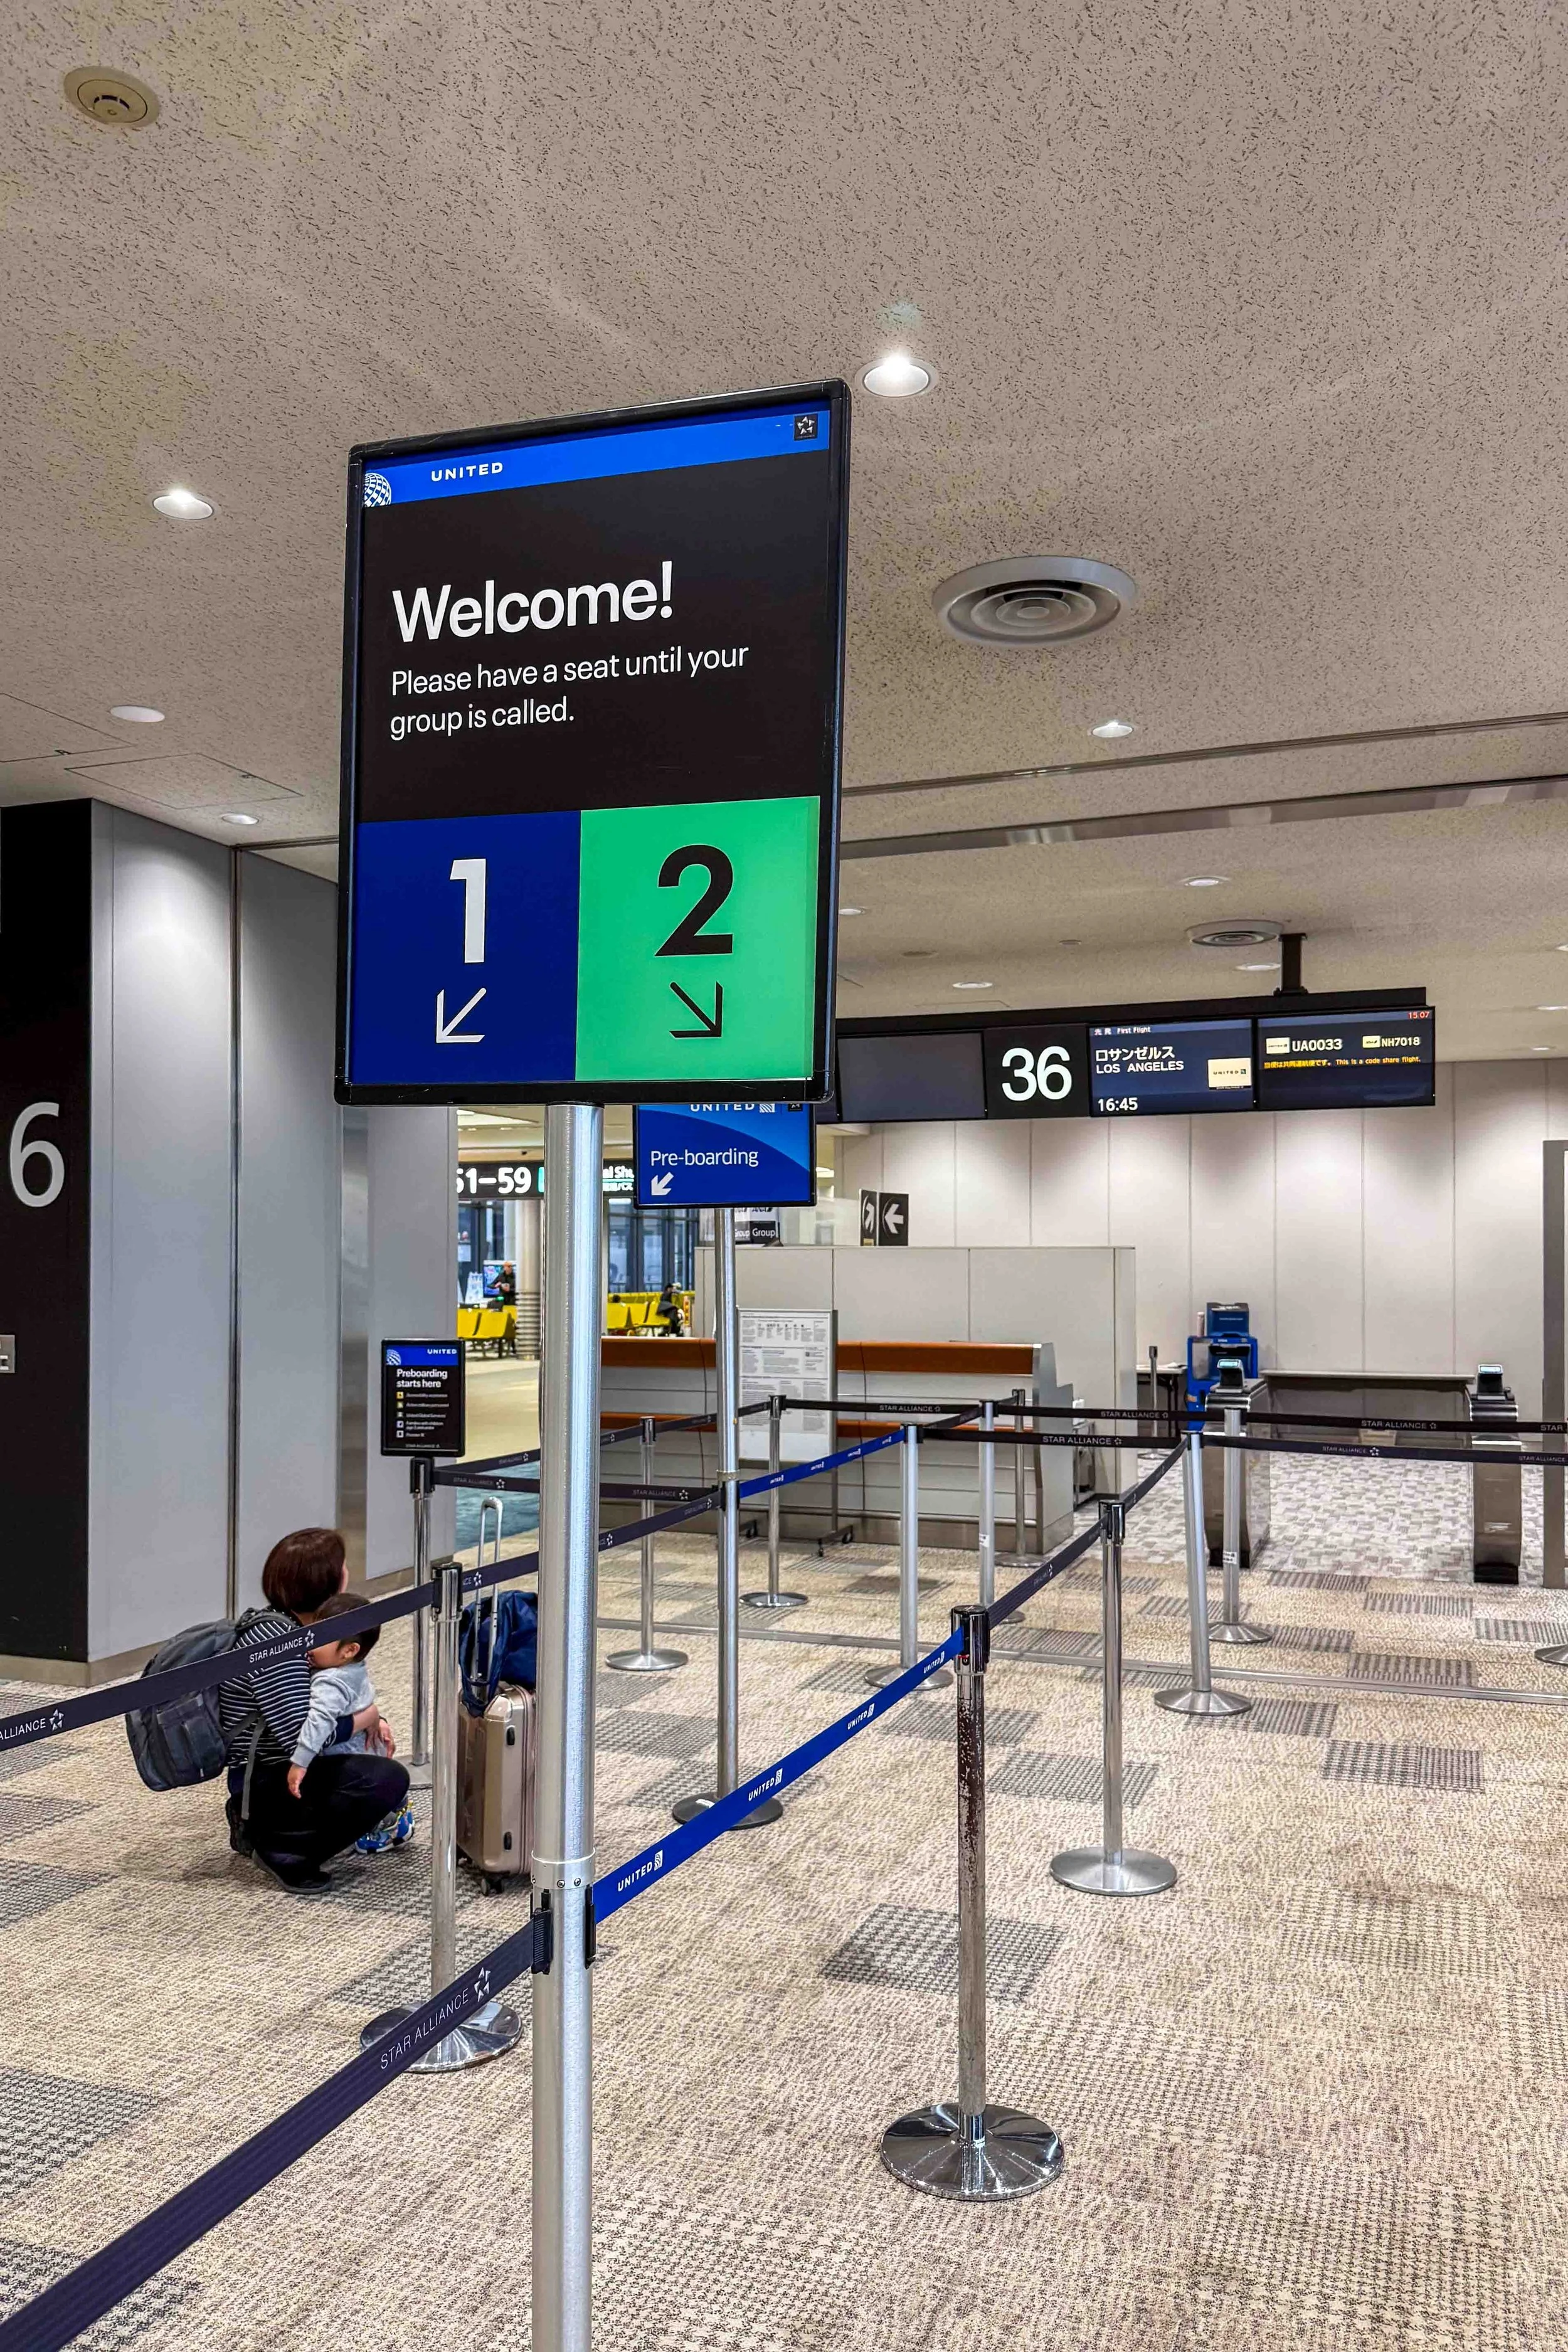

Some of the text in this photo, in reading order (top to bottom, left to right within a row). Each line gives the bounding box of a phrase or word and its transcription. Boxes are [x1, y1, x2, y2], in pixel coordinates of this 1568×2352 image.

[432, 462, 503, 482] UNITED
[392, 560, 672, 643] Welcome!
[392, 645, 749, 696] Please have a seat until your
[390, 696, 575, 741] group is called.
[655, 844, 734, 956] 2
[449, 858, 486, 963] 1
[1292, 1038, 1343, 1052] UA0033
[1381, 1036, 1421, 1047] NH7018
[1096, 1046, 1175, 1062] ロサンゼルス
[1002, 1045, 1073, 1101] 36
[1096, 1061, 1185, 1074] LOS ANGELES
[691, 1103, 755, 1112] UNITED
[1098, 1097, 1138, 1112] 16:45
[9, 1101, 65, 1207] 6
[650, 1147, 759, 1167] Pre-boarding
[752, 1228, 776, 1238] Group
[396, 1369, 448, 1379] Preboarding
[422, 1379, 442, 1387] here
[1385, 1421, 1427, 1429] ALLIANCE
[1067, 1436, 1112, 1445] ALLIANCE
[250, 1637, 303, 1663] STAR ALLIANCE
[923, 1656, 941, 1673] UNITED
[847, 1710, 868, 1730] UNITED
[748, 1777, 775, 1801] UNITED
[618, 1861, 653, 1892] UNITED
[381, 1988, 469, 2069] STAR ALLIANCE
